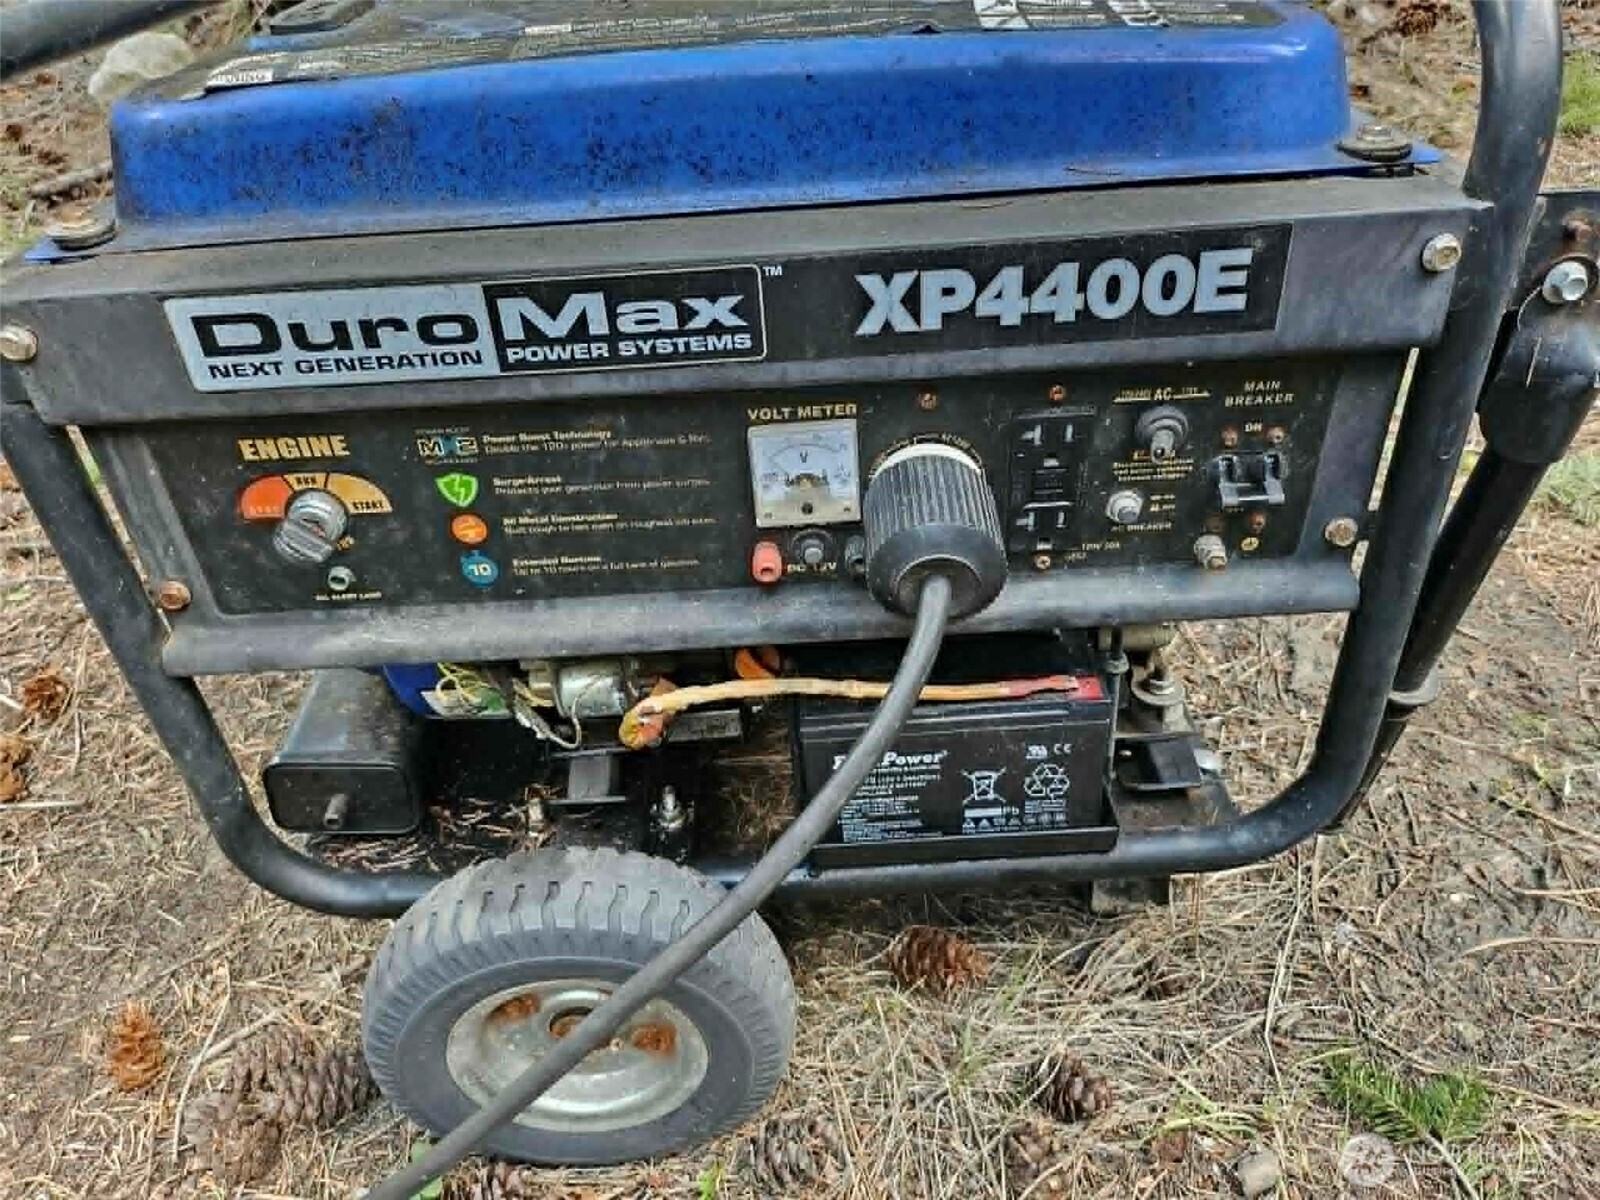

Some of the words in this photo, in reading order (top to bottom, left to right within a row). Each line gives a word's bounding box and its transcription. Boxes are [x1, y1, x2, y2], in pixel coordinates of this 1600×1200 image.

[854, 248, 1253, 338] XP4400E
[190, 312, 479, 358] Duro
[496, 291, 749, 341] Max
[762, 266, 783, 276] TM
[507, 343, 610, 363] POWER
[618, 333, 752, 357] SYSTEMS
[207, 360, 284, 379] NEXT
[295, 350, 482, 375] GENERATION
[1153, 387, 1172, 400] AC
[1244, 381, 1281, 392] MAIN
[1225, 393, 1295, 407] BREAKER
[748, 407, 796, 420] VOLT
[797, 404, 857, 418] METER
[1244, 421, 1263, 432] ON
[482, 435, 515, 444] Power
[552, 430, 612, 441] Technology
[237, 435, 350, 462] ENGINE
[800, 451, 809, 463] V
[550, 513, 618, 522] Construction
[1127, 522, 1172, 532] BREAKER
[512, 557, 558, 567] Extended
